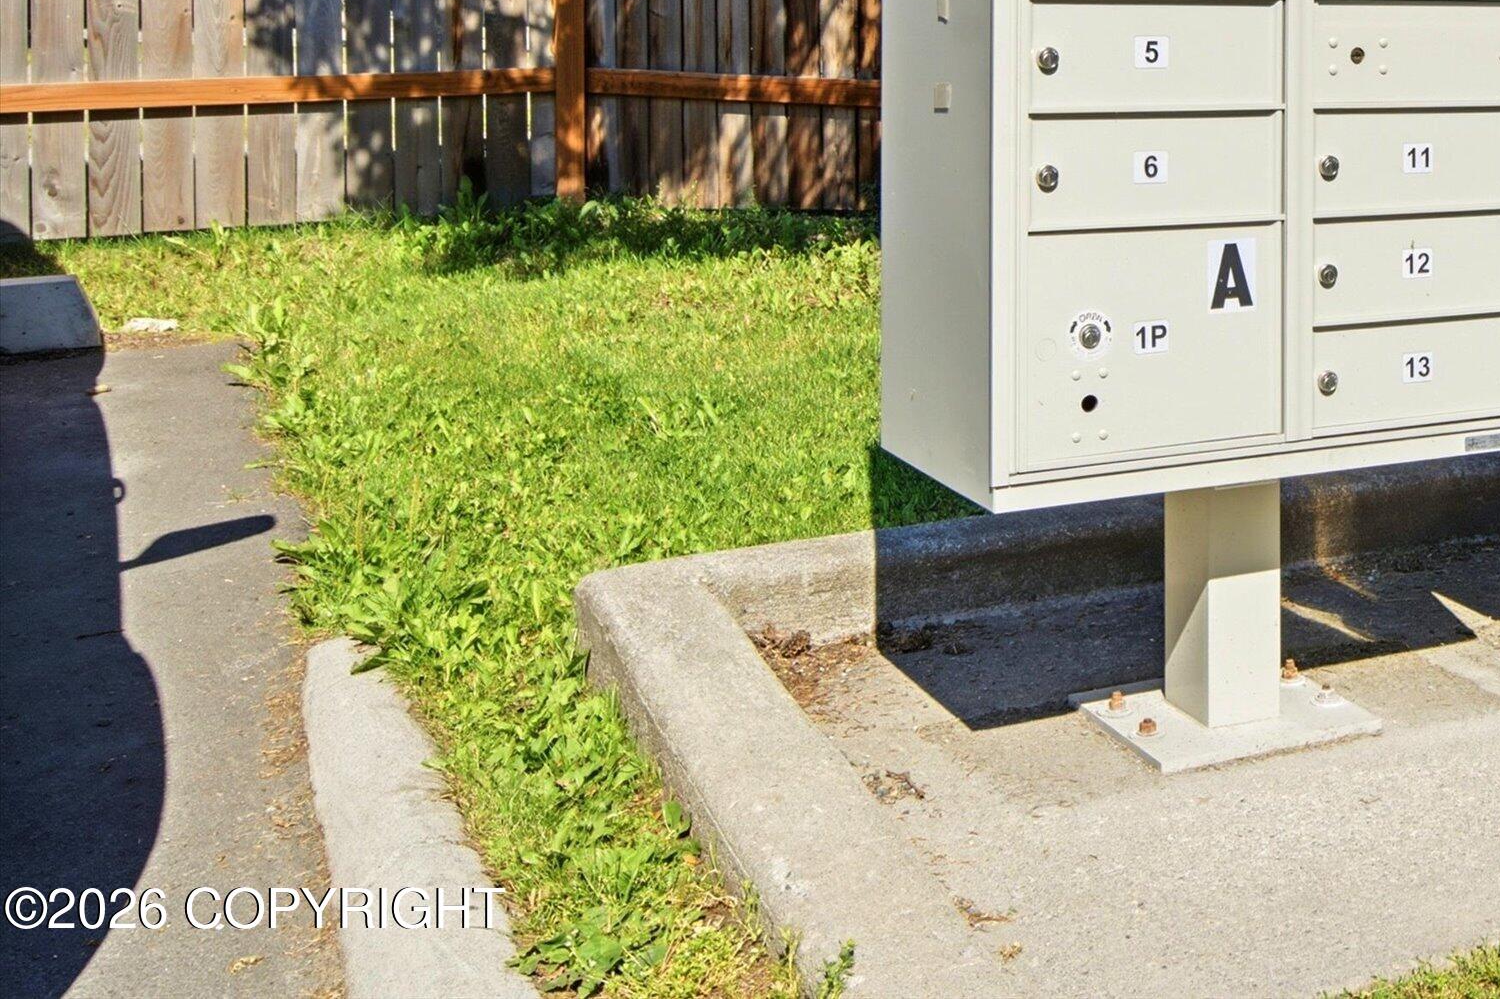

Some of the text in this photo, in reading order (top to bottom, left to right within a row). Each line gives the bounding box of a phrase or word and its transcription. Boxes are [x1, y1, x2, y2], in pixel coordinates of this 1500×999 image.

[1144, 40, 1159, 64] 5
[1144, 155, 1158, 179] 6
[1407, 147, 1430, 169] 11
[1405, 252, 1430, 275] 12
[1211, 243, 1253, 309] A
[1135, 325, 1167, 348] 1P
[1405, 356, 1430, 378] 13
